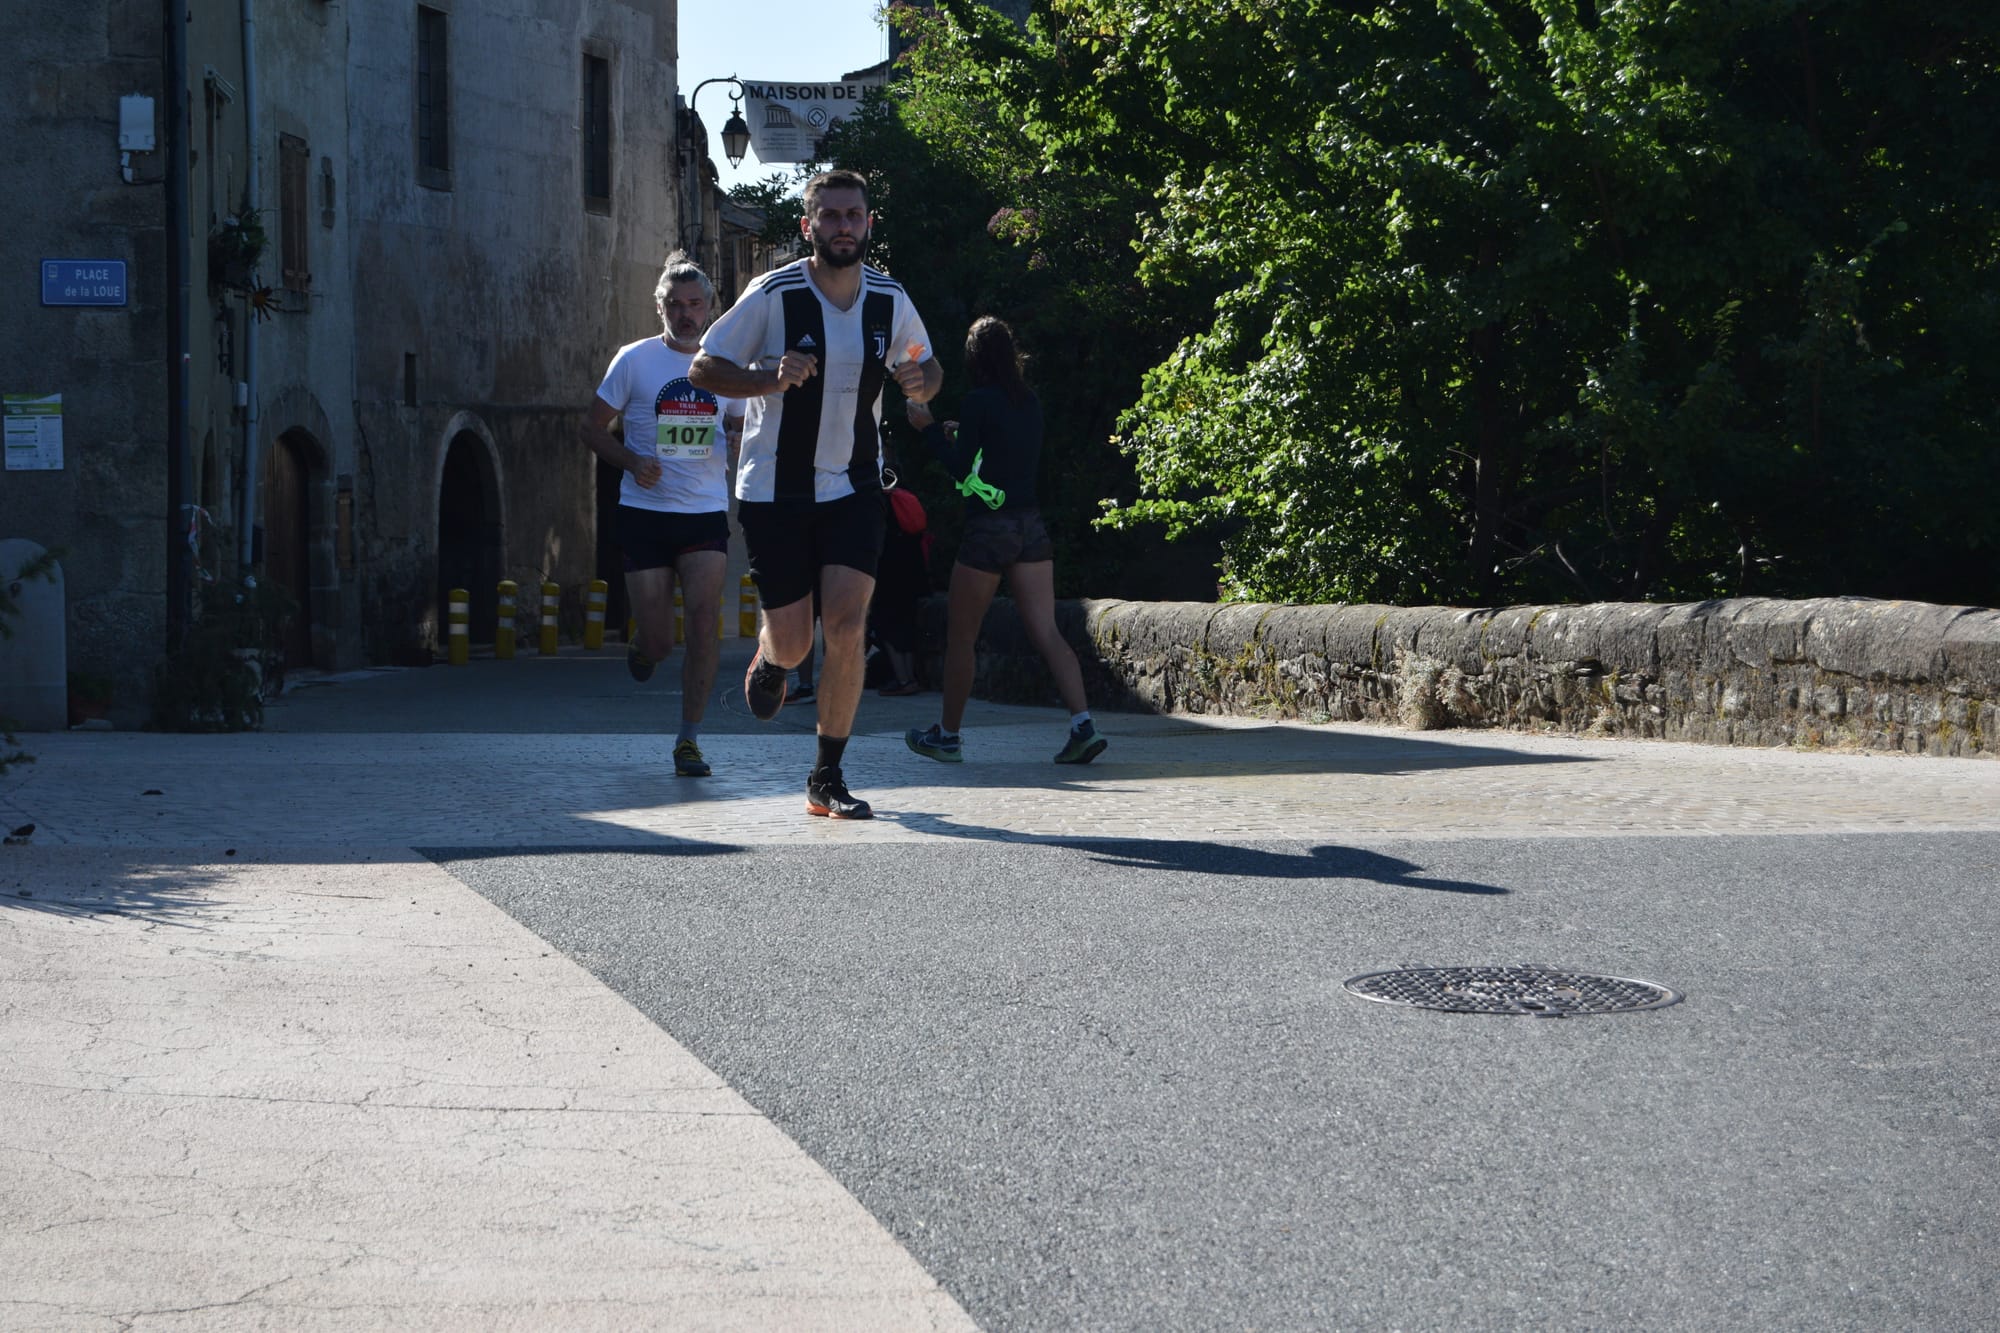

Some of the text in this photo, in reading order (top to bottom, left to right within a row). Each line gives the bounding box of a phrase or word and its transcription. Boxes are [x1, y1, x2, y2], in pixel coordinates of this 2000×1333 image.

[750, 86, 826, 100] MAISON
[833, 86, 857, 99] DE
[75, 269, 109, 280] PLACE
[65, 285, 121, 297] de la LOUE
[667, 426, 709, 445] 107
